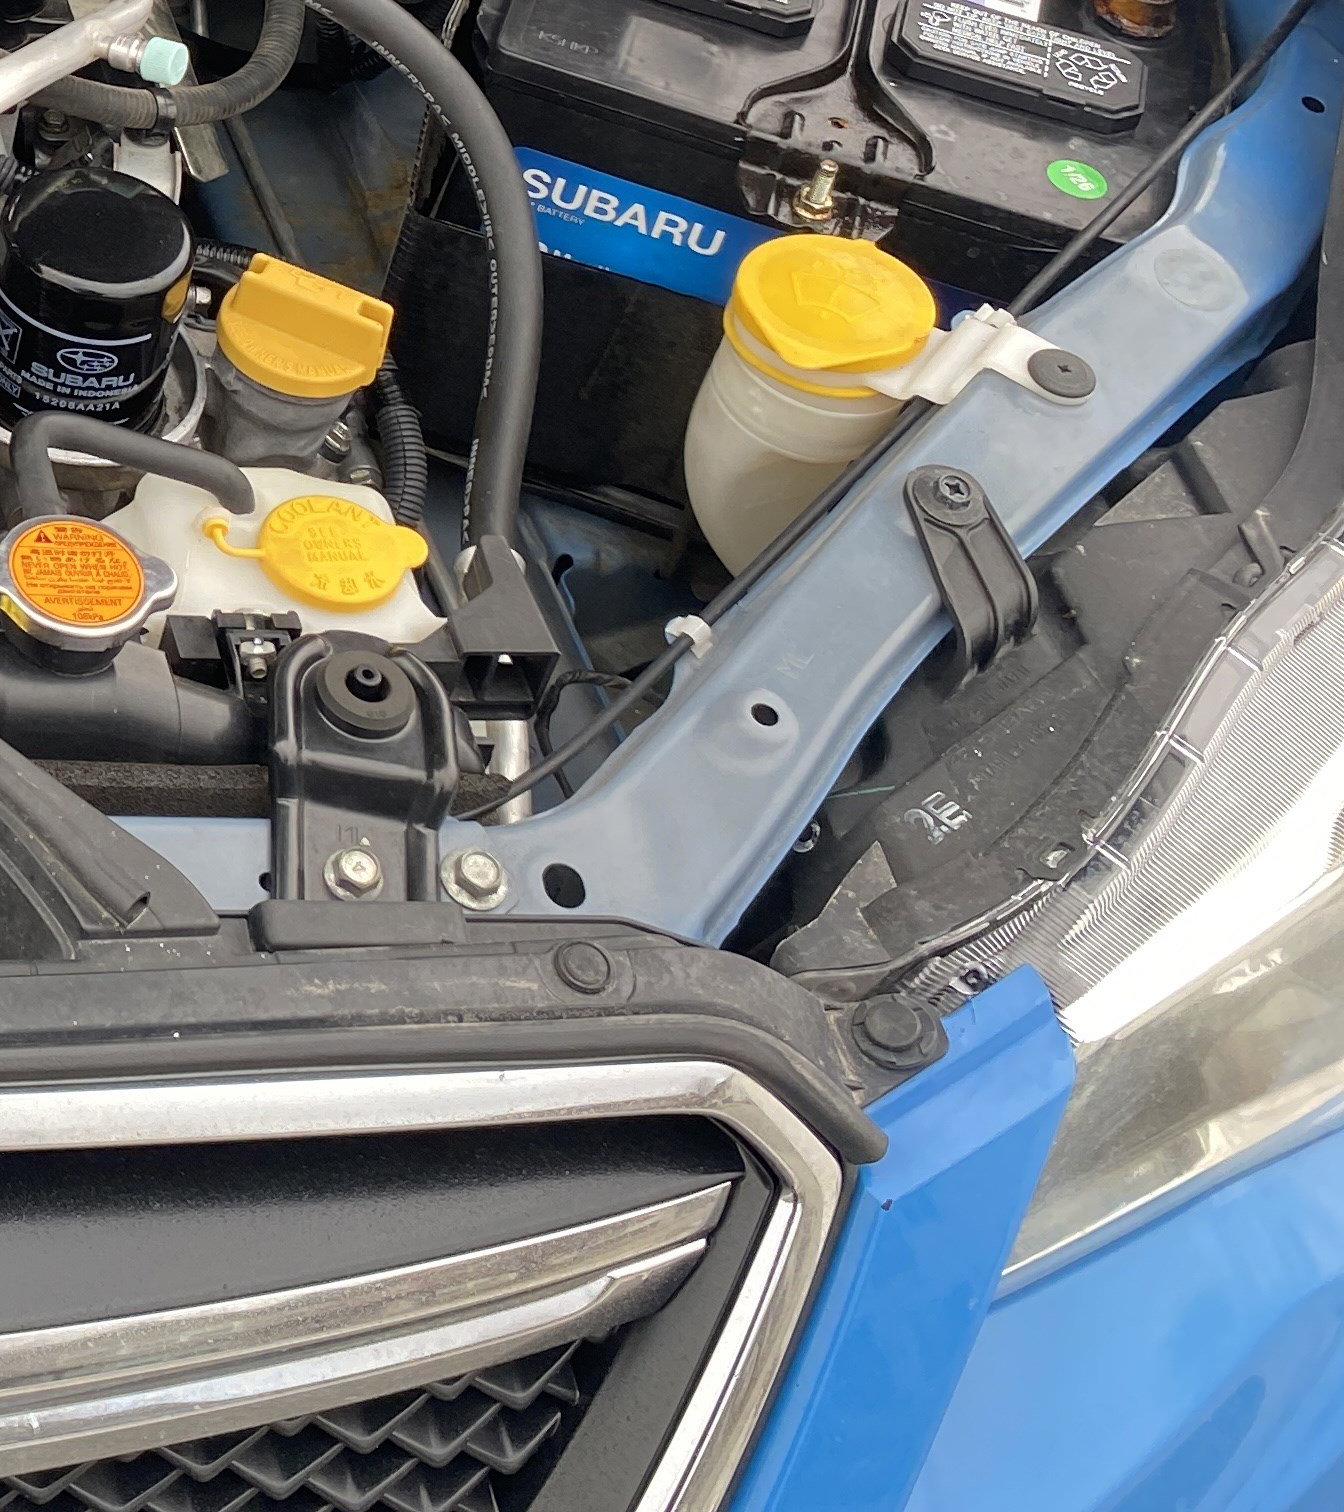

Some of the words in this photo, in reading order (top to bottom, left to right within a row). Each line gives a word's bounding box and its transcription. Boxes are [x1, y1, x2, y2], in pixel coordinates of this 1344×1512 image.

[1060, 164, 1096, 192] 1/26
[522, 168, 727, 256] SUBARU
[537, 204, 586, 227] BATTERY
[21, 369, 54, 390] MADE
[56, 384, 71, 396] IN
[73, 383, 139, 398] INDONESIA
[30, 361, 136, 389] SUBARU
[269, 499, 381, 535] COOLANT
[52, 533, 104, 542] WARNING
[22, 561, 51, 570] NEVER
[53, 562, 78, 570] OPEN
[80, 562, 106, 571] WHEN
[306, 550, 368, 562] MANUAL
[43, 596, 122, 607] AVERTISSEMENT
